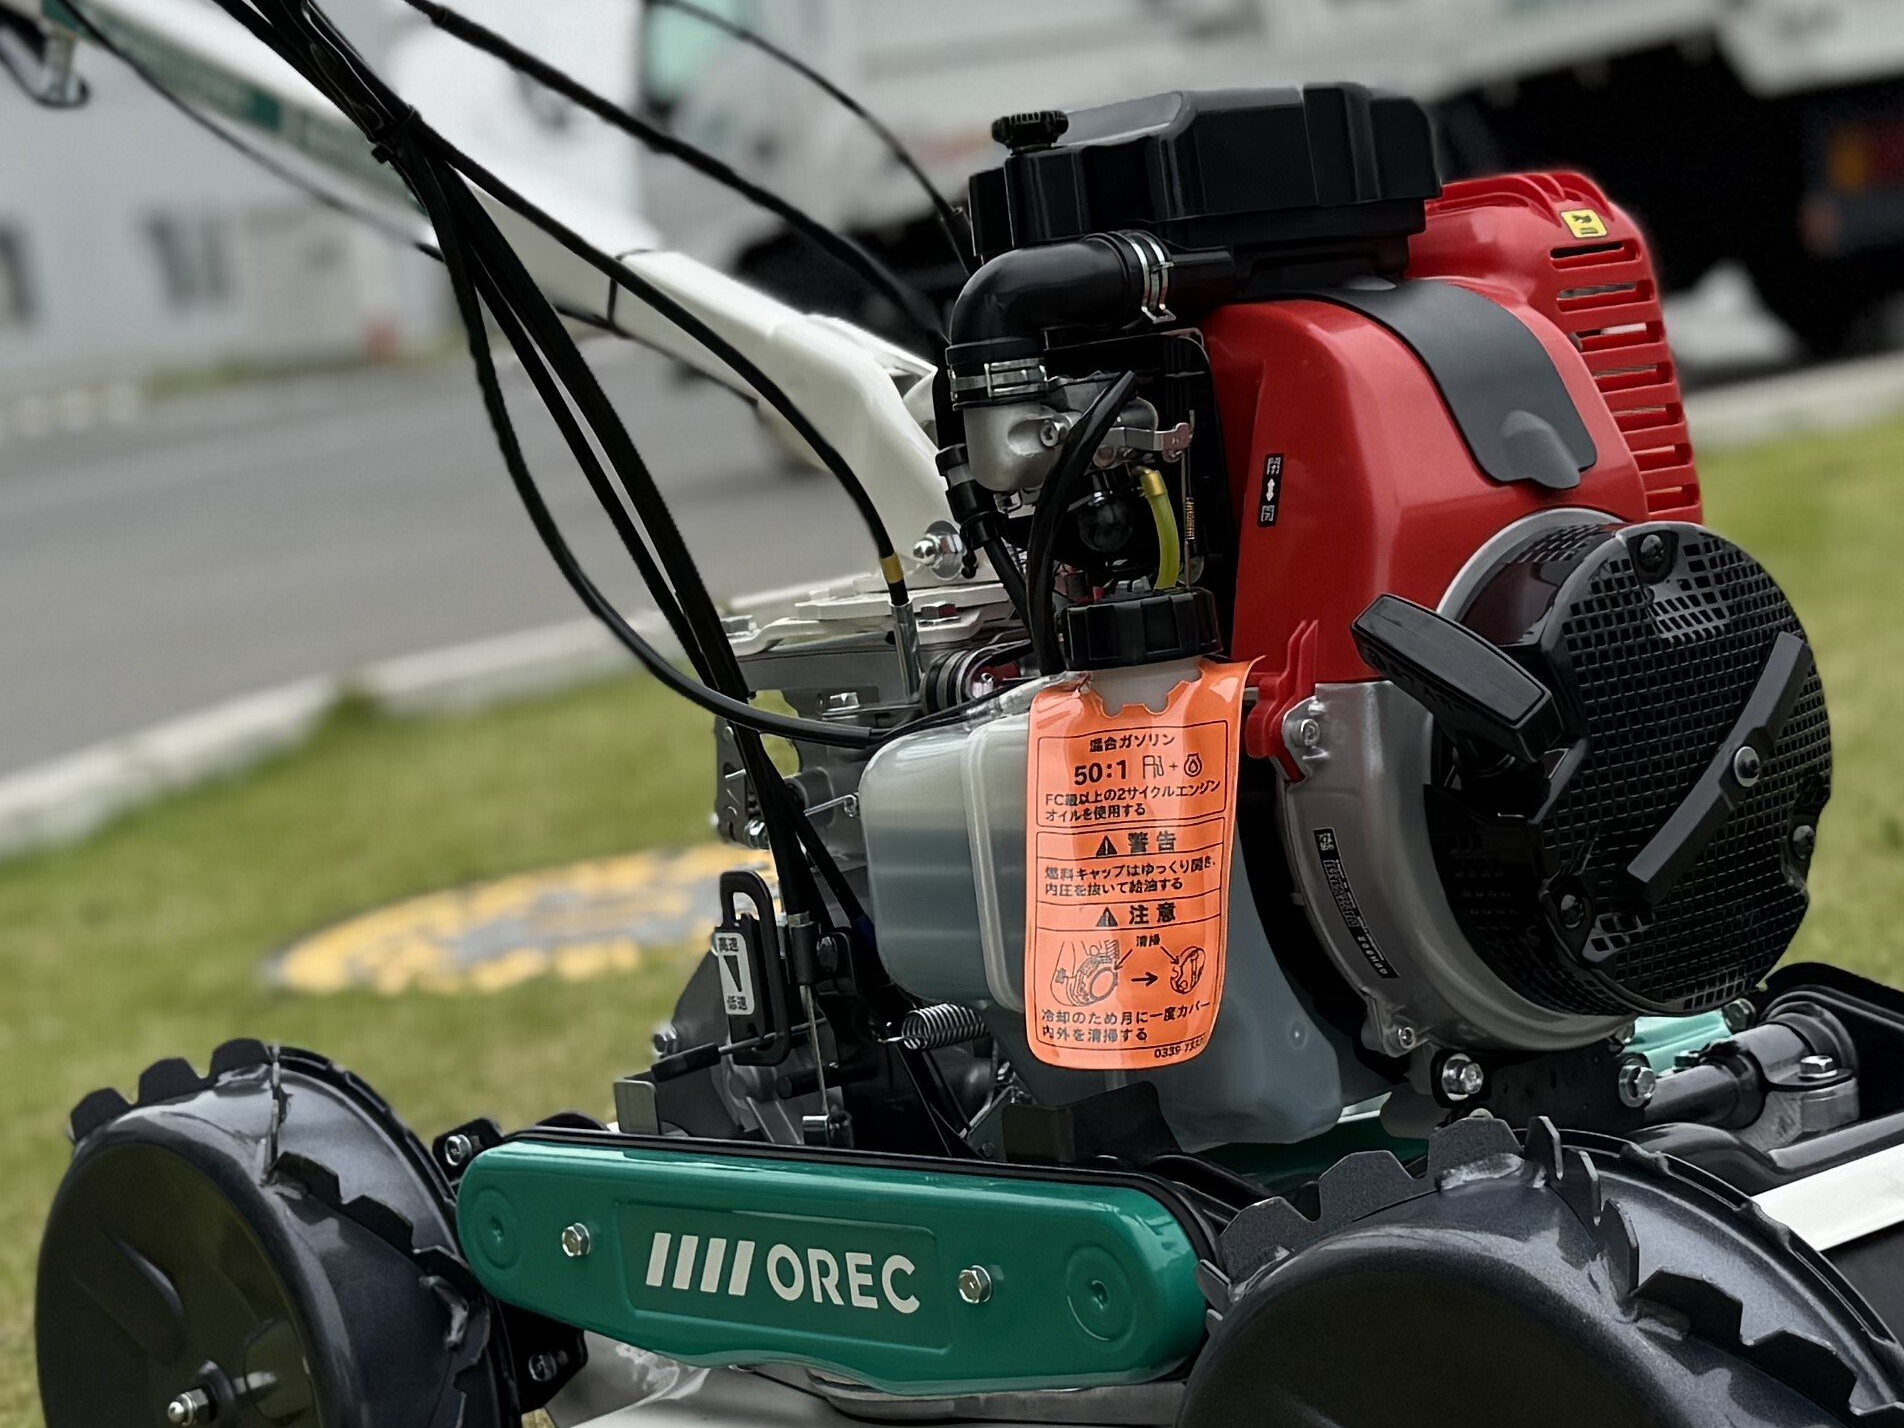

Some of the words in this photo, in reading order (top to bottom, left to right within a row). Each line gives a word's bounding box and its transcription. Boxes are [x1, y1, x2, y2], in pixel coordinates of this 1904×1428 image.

[1089, 732, 1175, 753] 混合ガソリン
[1074, 759, 1127, 786] 50:1
[1045, 803, 1146, 822] オイルを使用する
[1127, 830, 1177, 854] 警告
[1045, 877, 1183, 897] 内圧を抜いて給油する
[1128, 902, 1176, 925] 注意
[1042, 1026, 1149, 1043] 内外を清掃する
[766, 1244, 921, 1314] OREC
